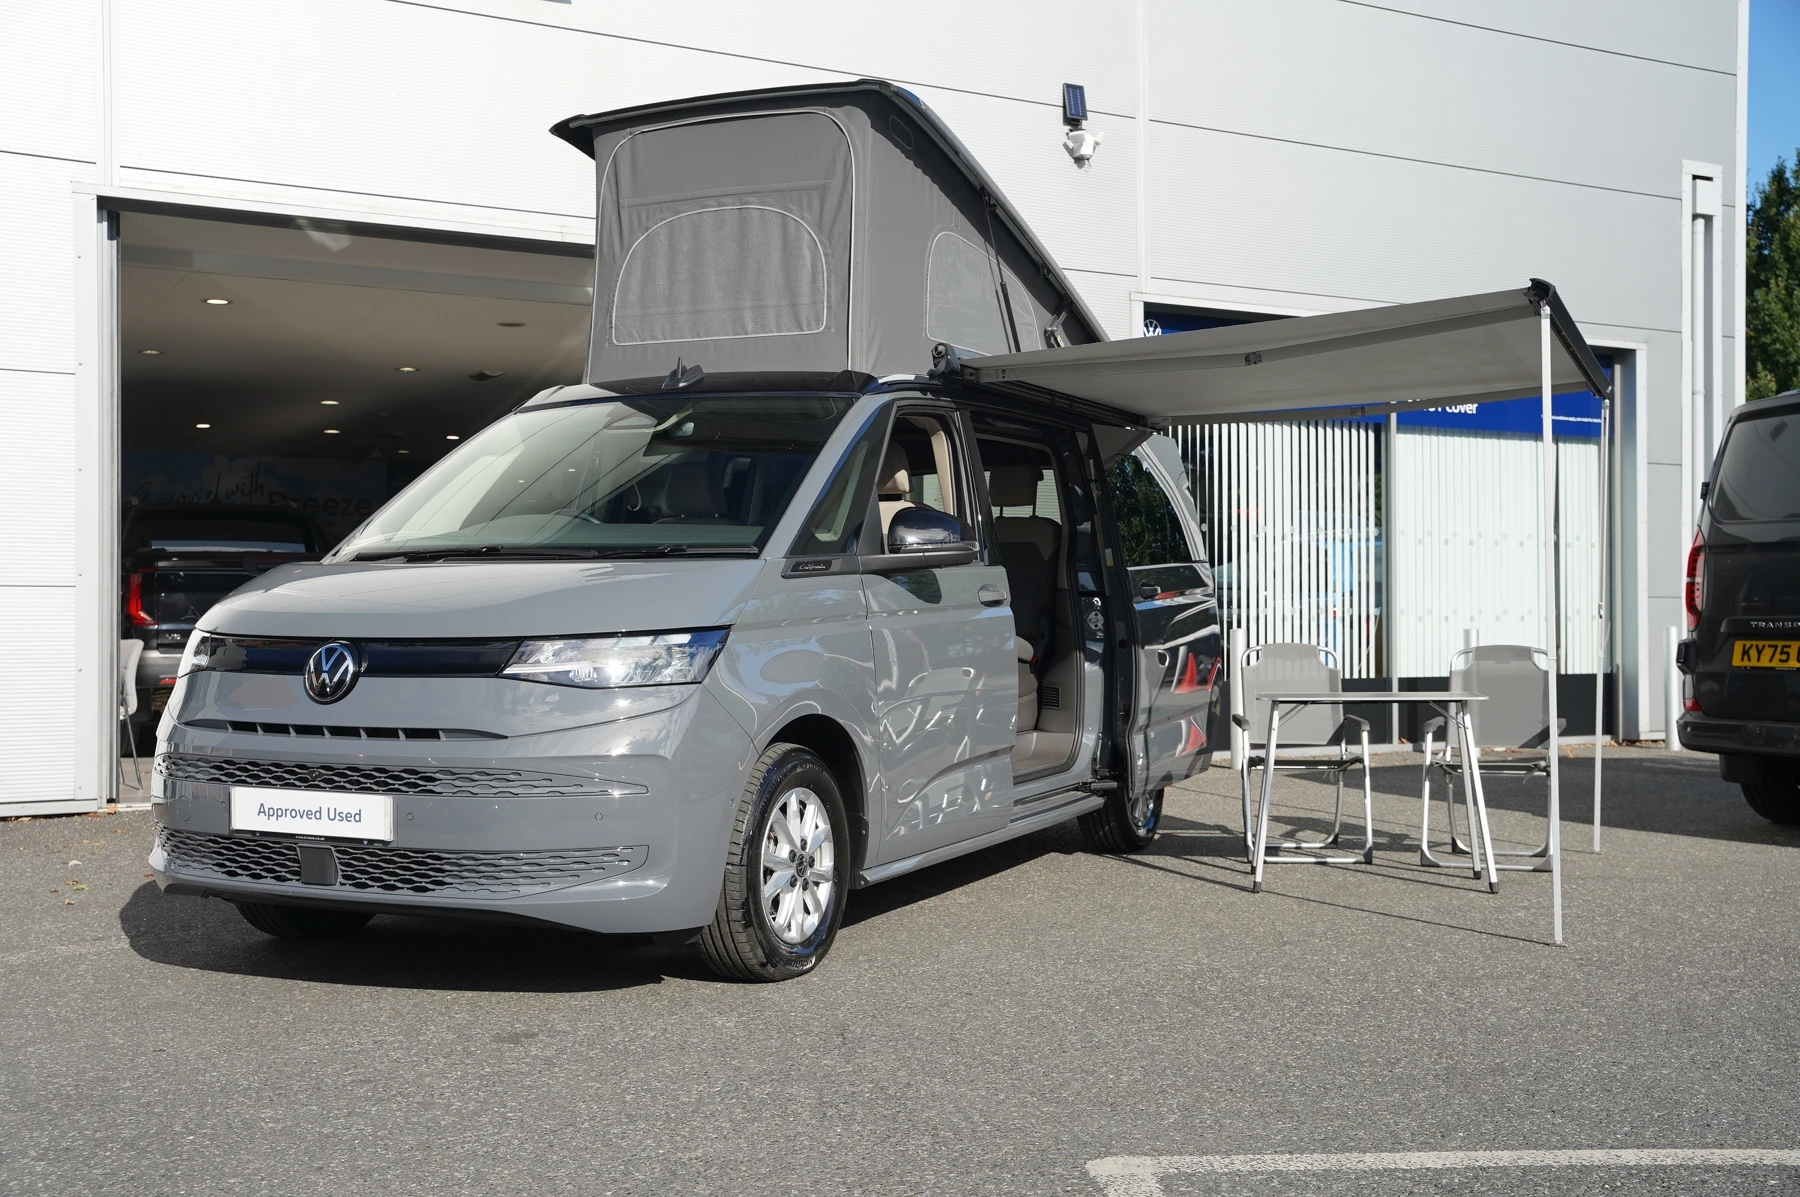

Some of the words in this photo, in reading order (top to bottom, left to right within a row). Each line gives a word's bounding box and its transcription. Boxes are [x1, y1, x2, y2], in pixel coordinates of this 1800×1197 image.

[226, 461, 264, 502] with
[1741, 643, 1792, 663] KY75
[257, 802, 323, 821] Approved
[327, 807, 362, 823] Used
